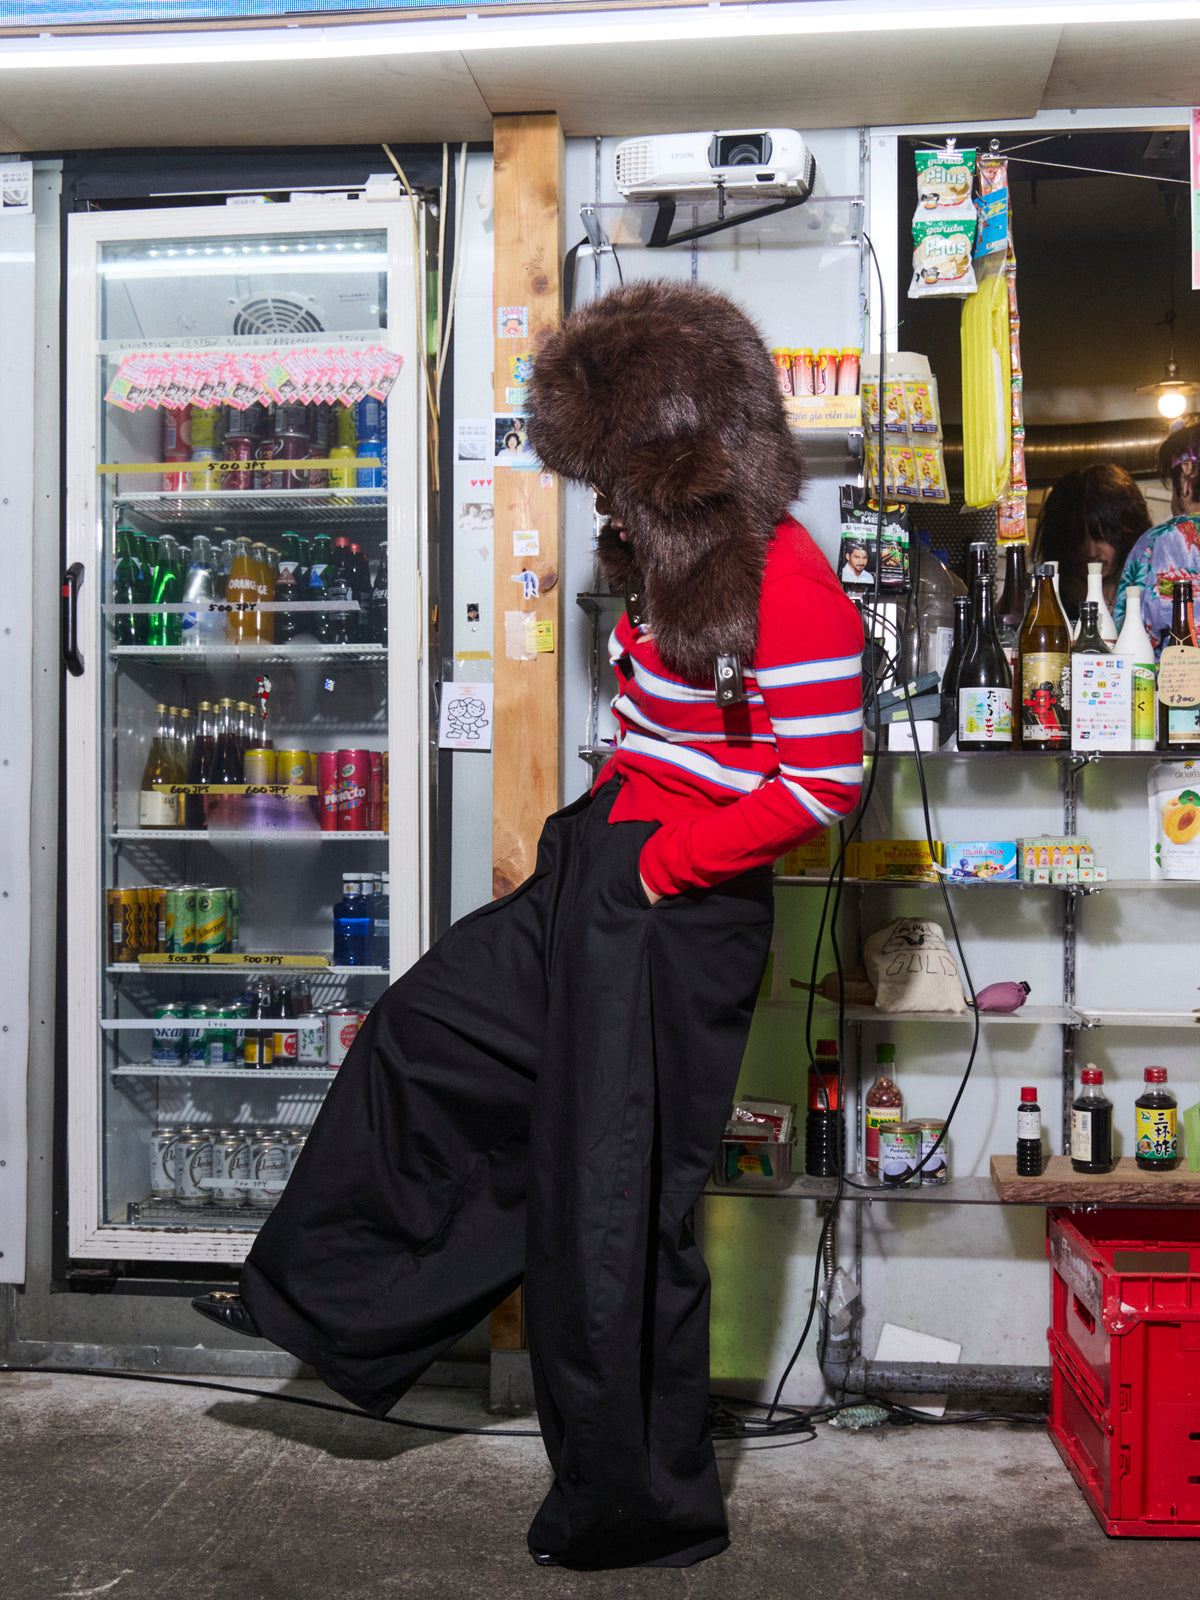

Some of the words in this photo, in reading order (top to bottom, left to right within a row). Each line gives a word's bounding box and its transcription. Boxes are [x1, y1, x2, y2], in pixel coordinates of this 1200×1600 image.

[925, 168, 967, 185] Pilus
[925, 224, 965, 234] garuda
[924, 237, 967, 257] Pilus
[208, 462, 240, 471] 500
[244, 461, 266, 470] JPY
[208, 603, 233, 612] 500
[235, 603, 257, 611] JPY
[170, 785, 191, 794] 600
[192, 785, 210, 794] JPY
[245, 785, 268, 794] 600
[269, 785, 289, 794] JPY
[962, 848, 983, 856] TOLAK
[984, 848, 1004, 856] ANGIN
[168, 954, 188, 962] 500
[191, 954, 210, 963] JPY
[243, 955, 262, 963] 500
[264, 955, 284, 965] JPY
[885, 952, 958, 977] GOLD
[1154, 1112, 1170, 1157] 三杯酢
